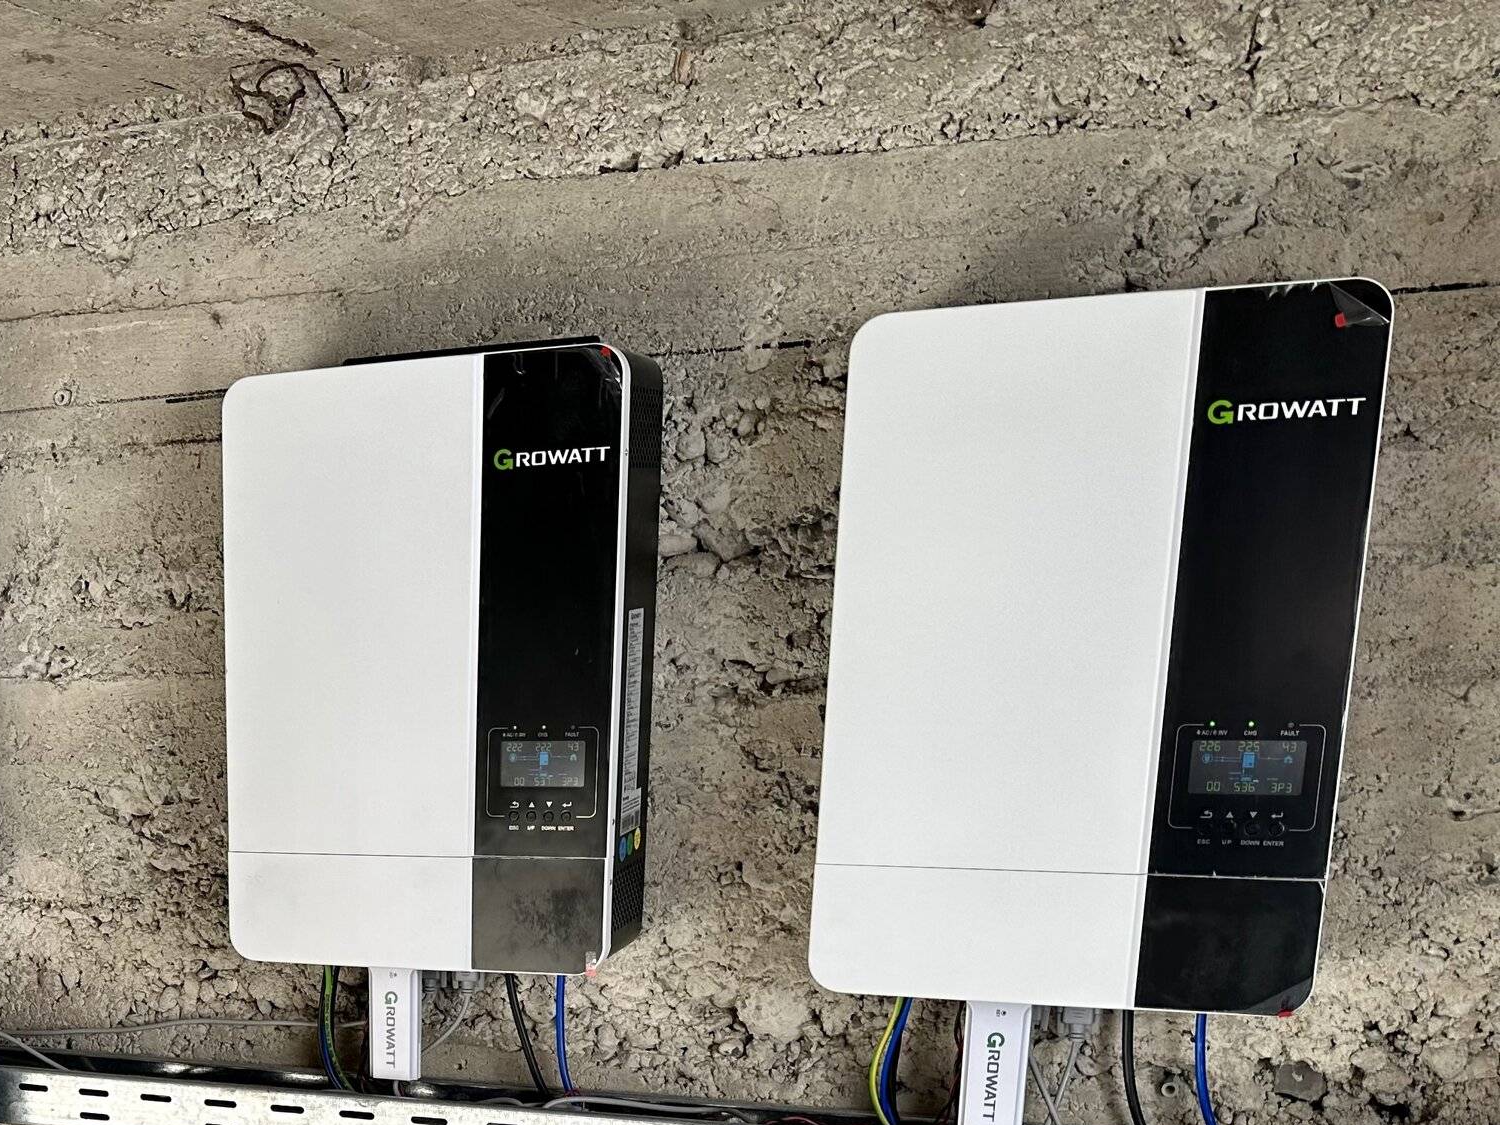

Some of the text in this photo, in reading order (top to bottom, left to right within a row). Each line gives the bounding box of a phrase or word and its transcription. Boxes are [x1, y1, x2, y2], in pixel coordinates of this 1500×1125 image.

[1207, 397, 1367, 425] GROWATT
[493, 446, 611, 470] GROWATT
[1240, 839, 1260, 847] DOWN
[1263, 840, 1285, 848] ENTER
[384, 990, 399, 1068] GROWATT
[982, 1031, 1006, 1122] GROWATT
